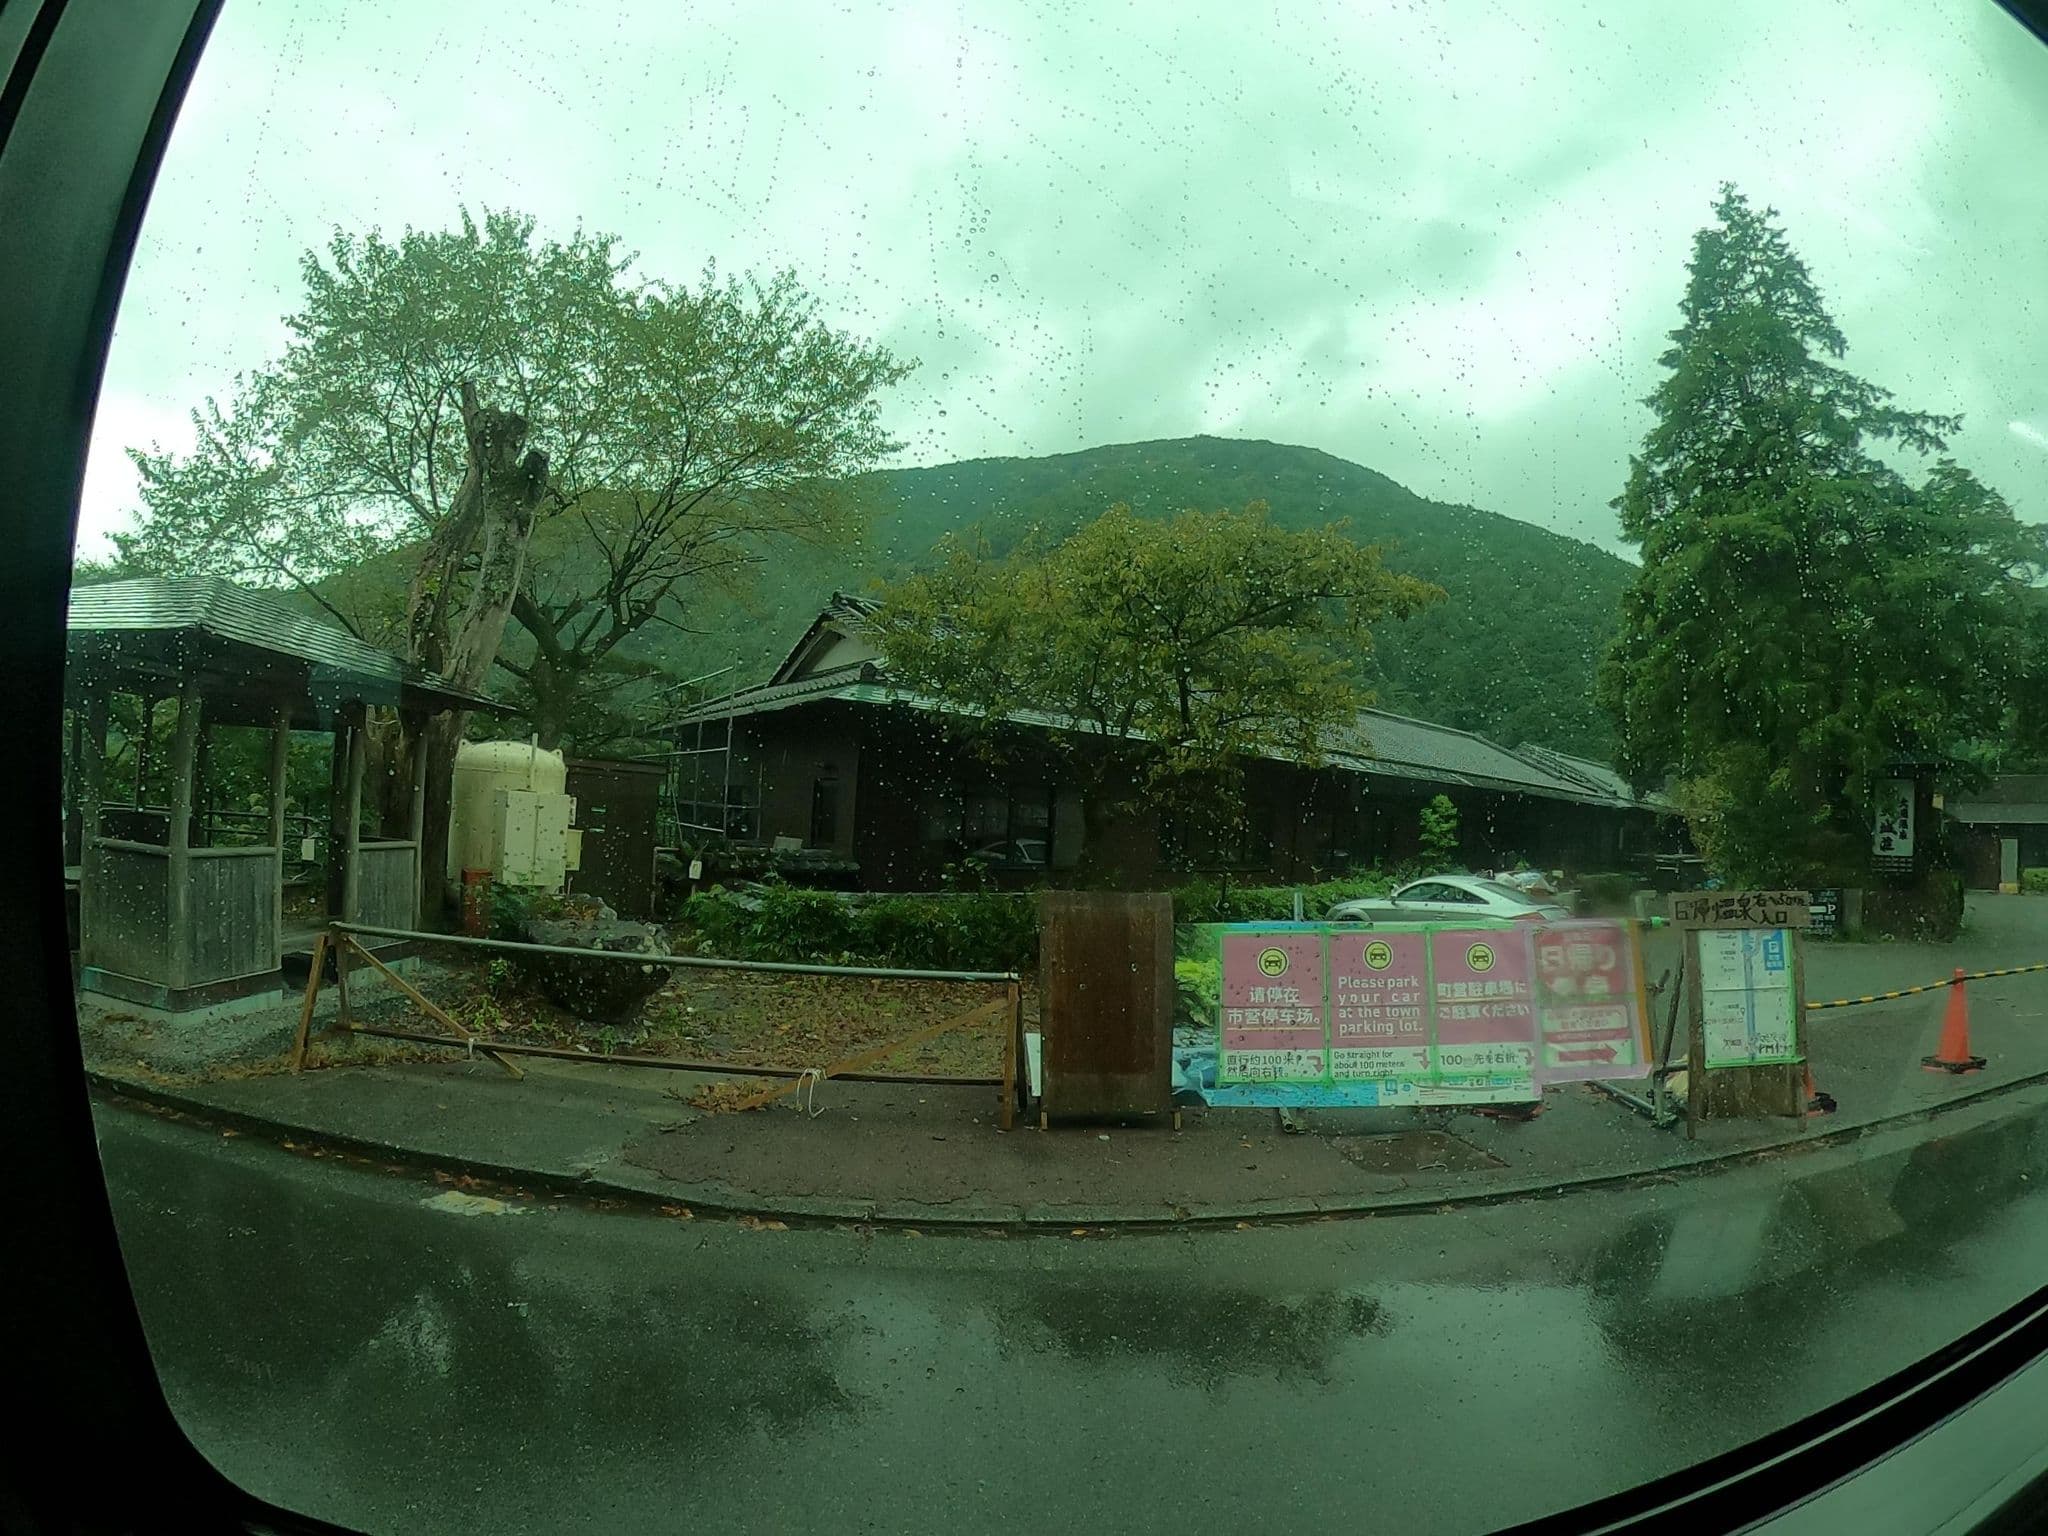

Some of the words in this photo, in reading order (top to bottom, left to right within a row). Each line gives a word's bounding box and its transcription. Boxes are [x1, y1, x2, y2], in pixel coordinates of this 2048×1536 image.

[1828, 904, 1836, 915] P
[1338, 976, 1384, 989] Please
[1387, 975, 1419, 991] park
[1249, 986, 1300, 1003] 请停在
[1338, 992, 1380, 1006] your
[1391, 991, 1420, 1003] car
[1338, 1007, 1352, 1019] at
[1358, 1006, 1380, 1018] the
[1386, 1005, 1420, 1018] town
[1339, 1019, 1394, 1036] parking
[1399, 1018, 1423, 1032] lot.
[1334, 1051, 1345, 1060] Go
[1347, 1050, 1379, 1060] straight
[1382, 1050, 1393, 1058] for
[1334, 1061, 1357, 1069] about
[1360, 1060, 1374, 1069] 100
[1376, 1060, 1405, 1068] meters
[1334, 1070, 1350, 1079] and
[1352, 1069, 1370, 1079] turn
